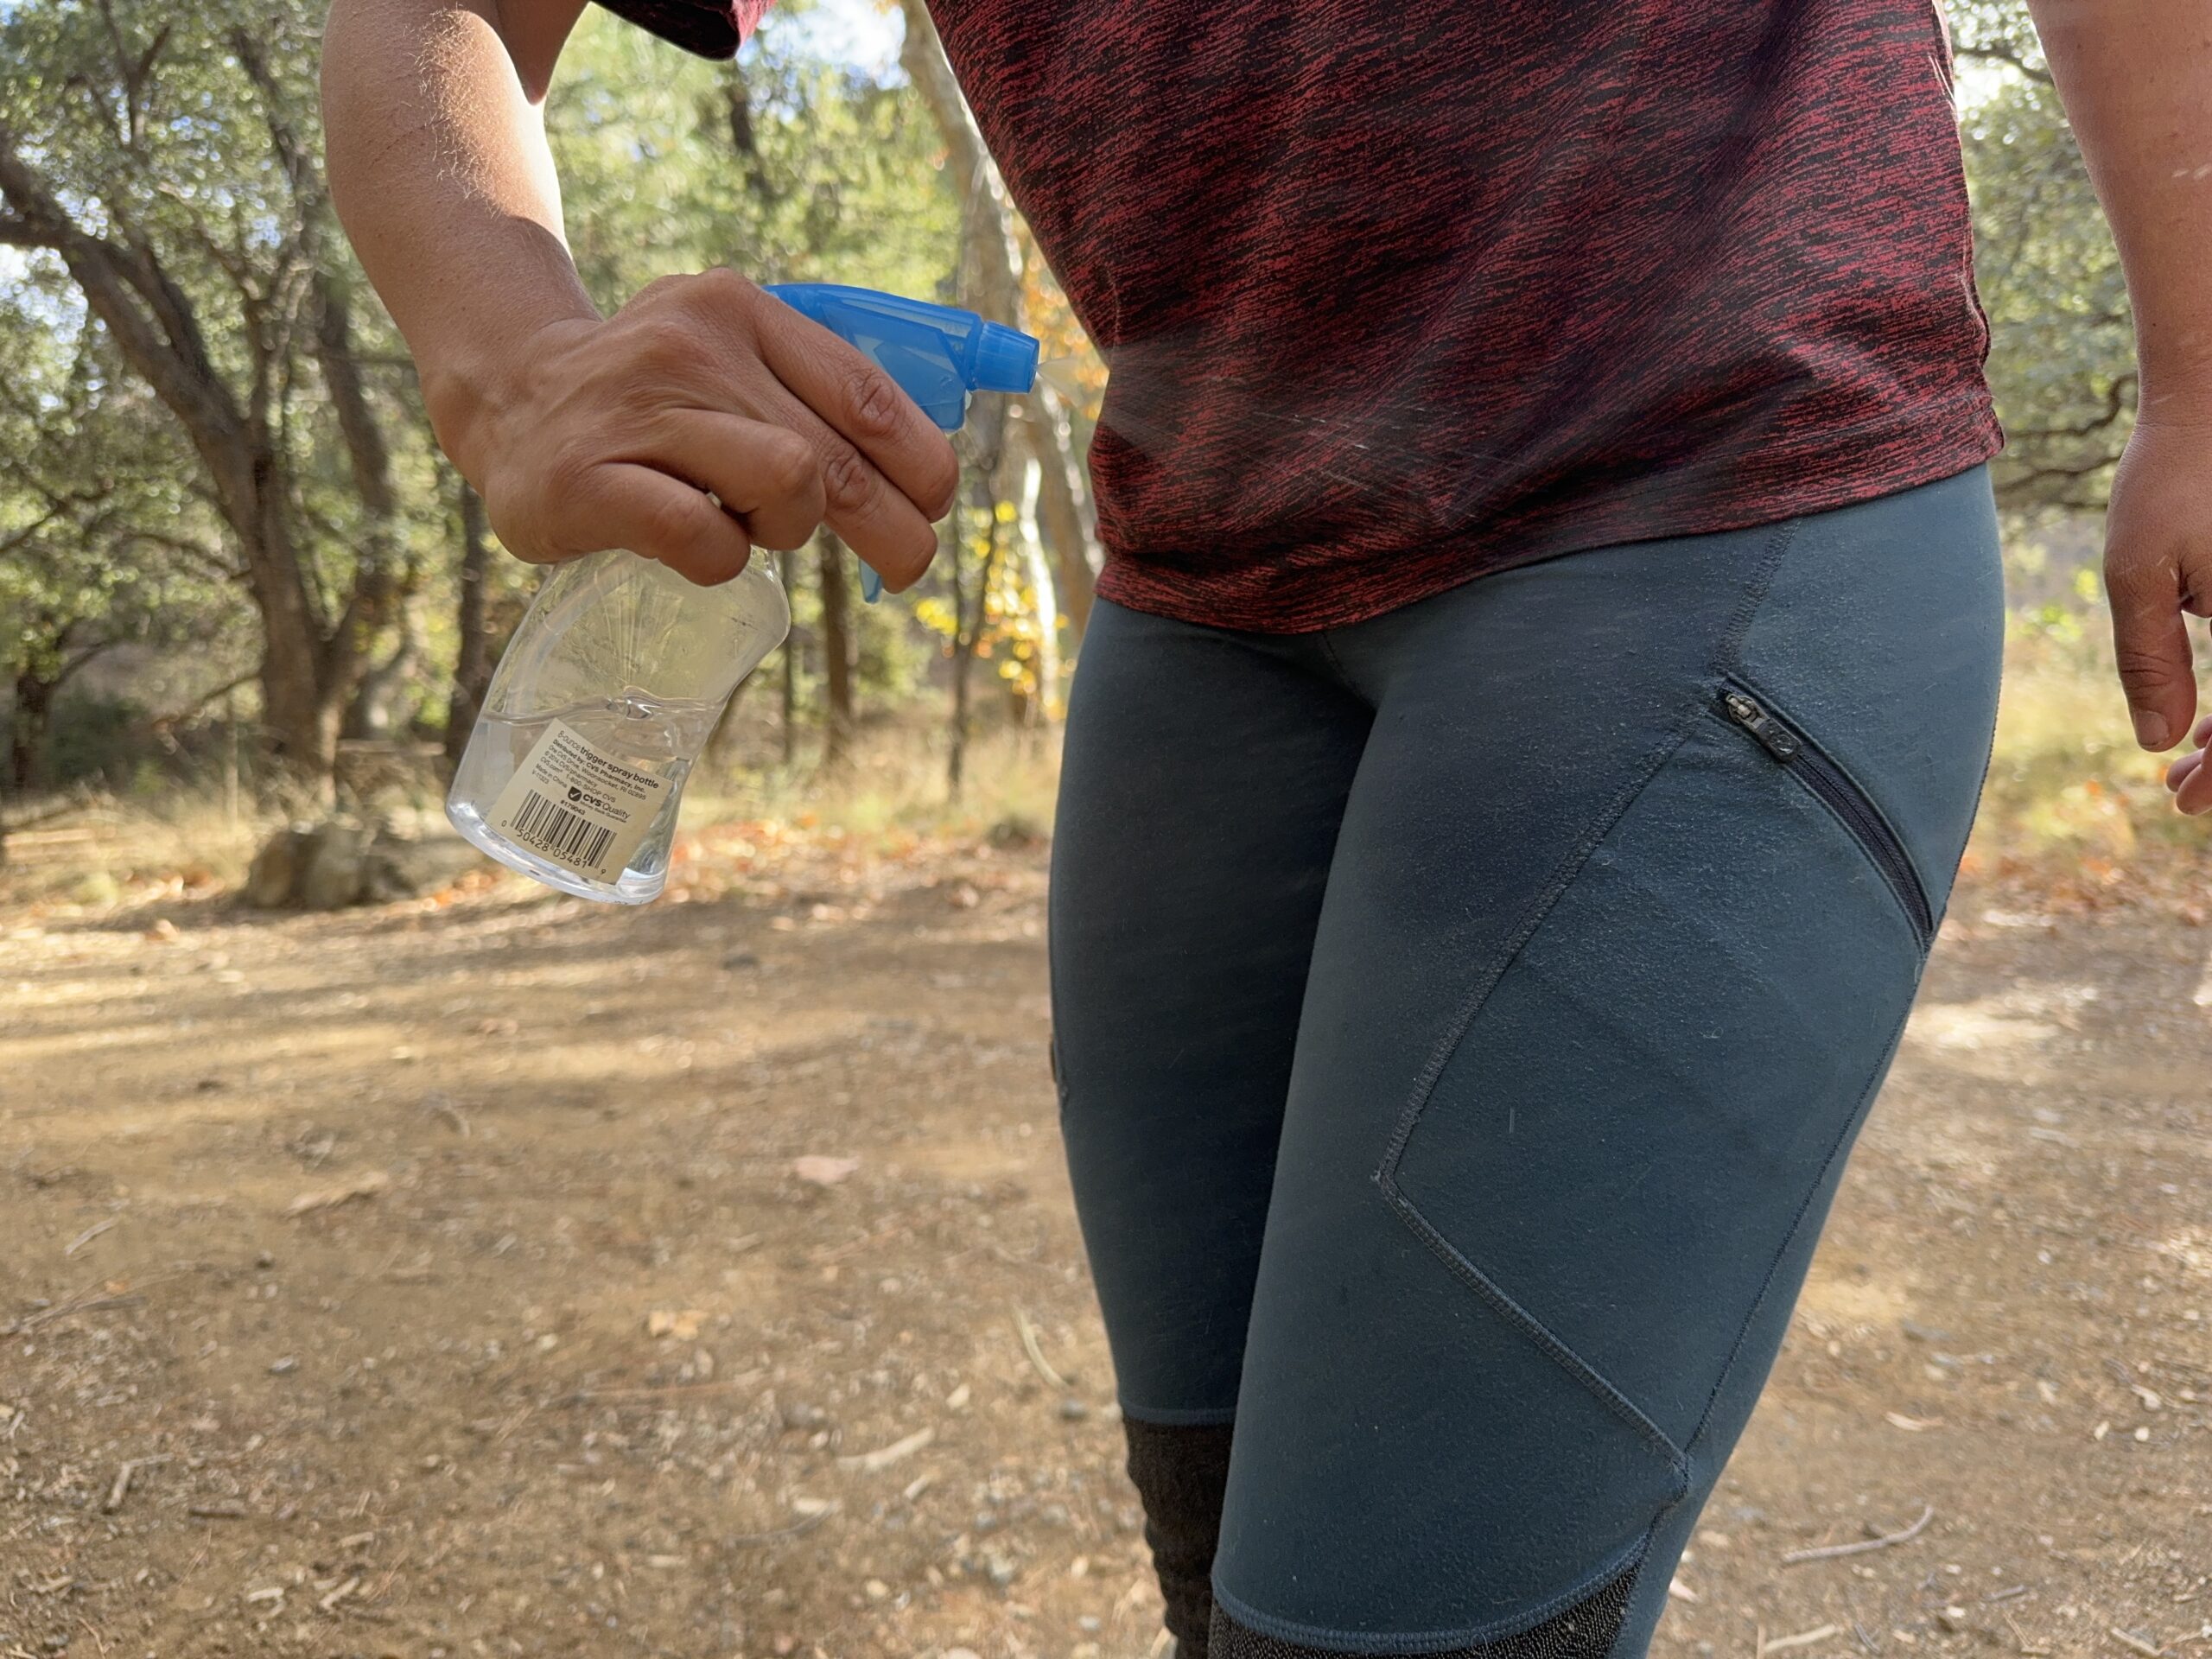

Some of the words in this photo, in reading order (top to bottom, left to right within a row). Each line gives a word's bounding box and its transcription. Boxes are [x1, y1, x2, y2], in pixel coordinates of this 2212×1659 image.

[536, 763, 548, 774] Made
[552, 775, 567, 788] China
[549, 753, 559, 763] 2014
[559, 760, 598, 787] CVS/pharmacy
[549, 745, 557, 753] One
[557, 751, 567, 760] CVS
[582, 767, 619, 790] Woonsocket,
[627, 789, 646, 800] 02895
[553, 739, 577, 759] Distributed
[586, 762, 600, 772] CVS
[600, 769, 632, 788] Pharmacy,
[633, 784, 645, 792] Inc.
[557, 730, 581, 751] 8-ounce
[580, 746, 608, 766] trigger
[607, 763, 633, 779] spray
[633, 772, 659, 789] bottle
[566, 774, 601, 795] 1-800-SHOP
[602, 793, 616, 803] CVS
[560, 799, 586, 816] #179043
[602, 803, 631, 819] Quality
[517, 829, 550, 852] 50428
[553, 849, 588, 868] 05481
